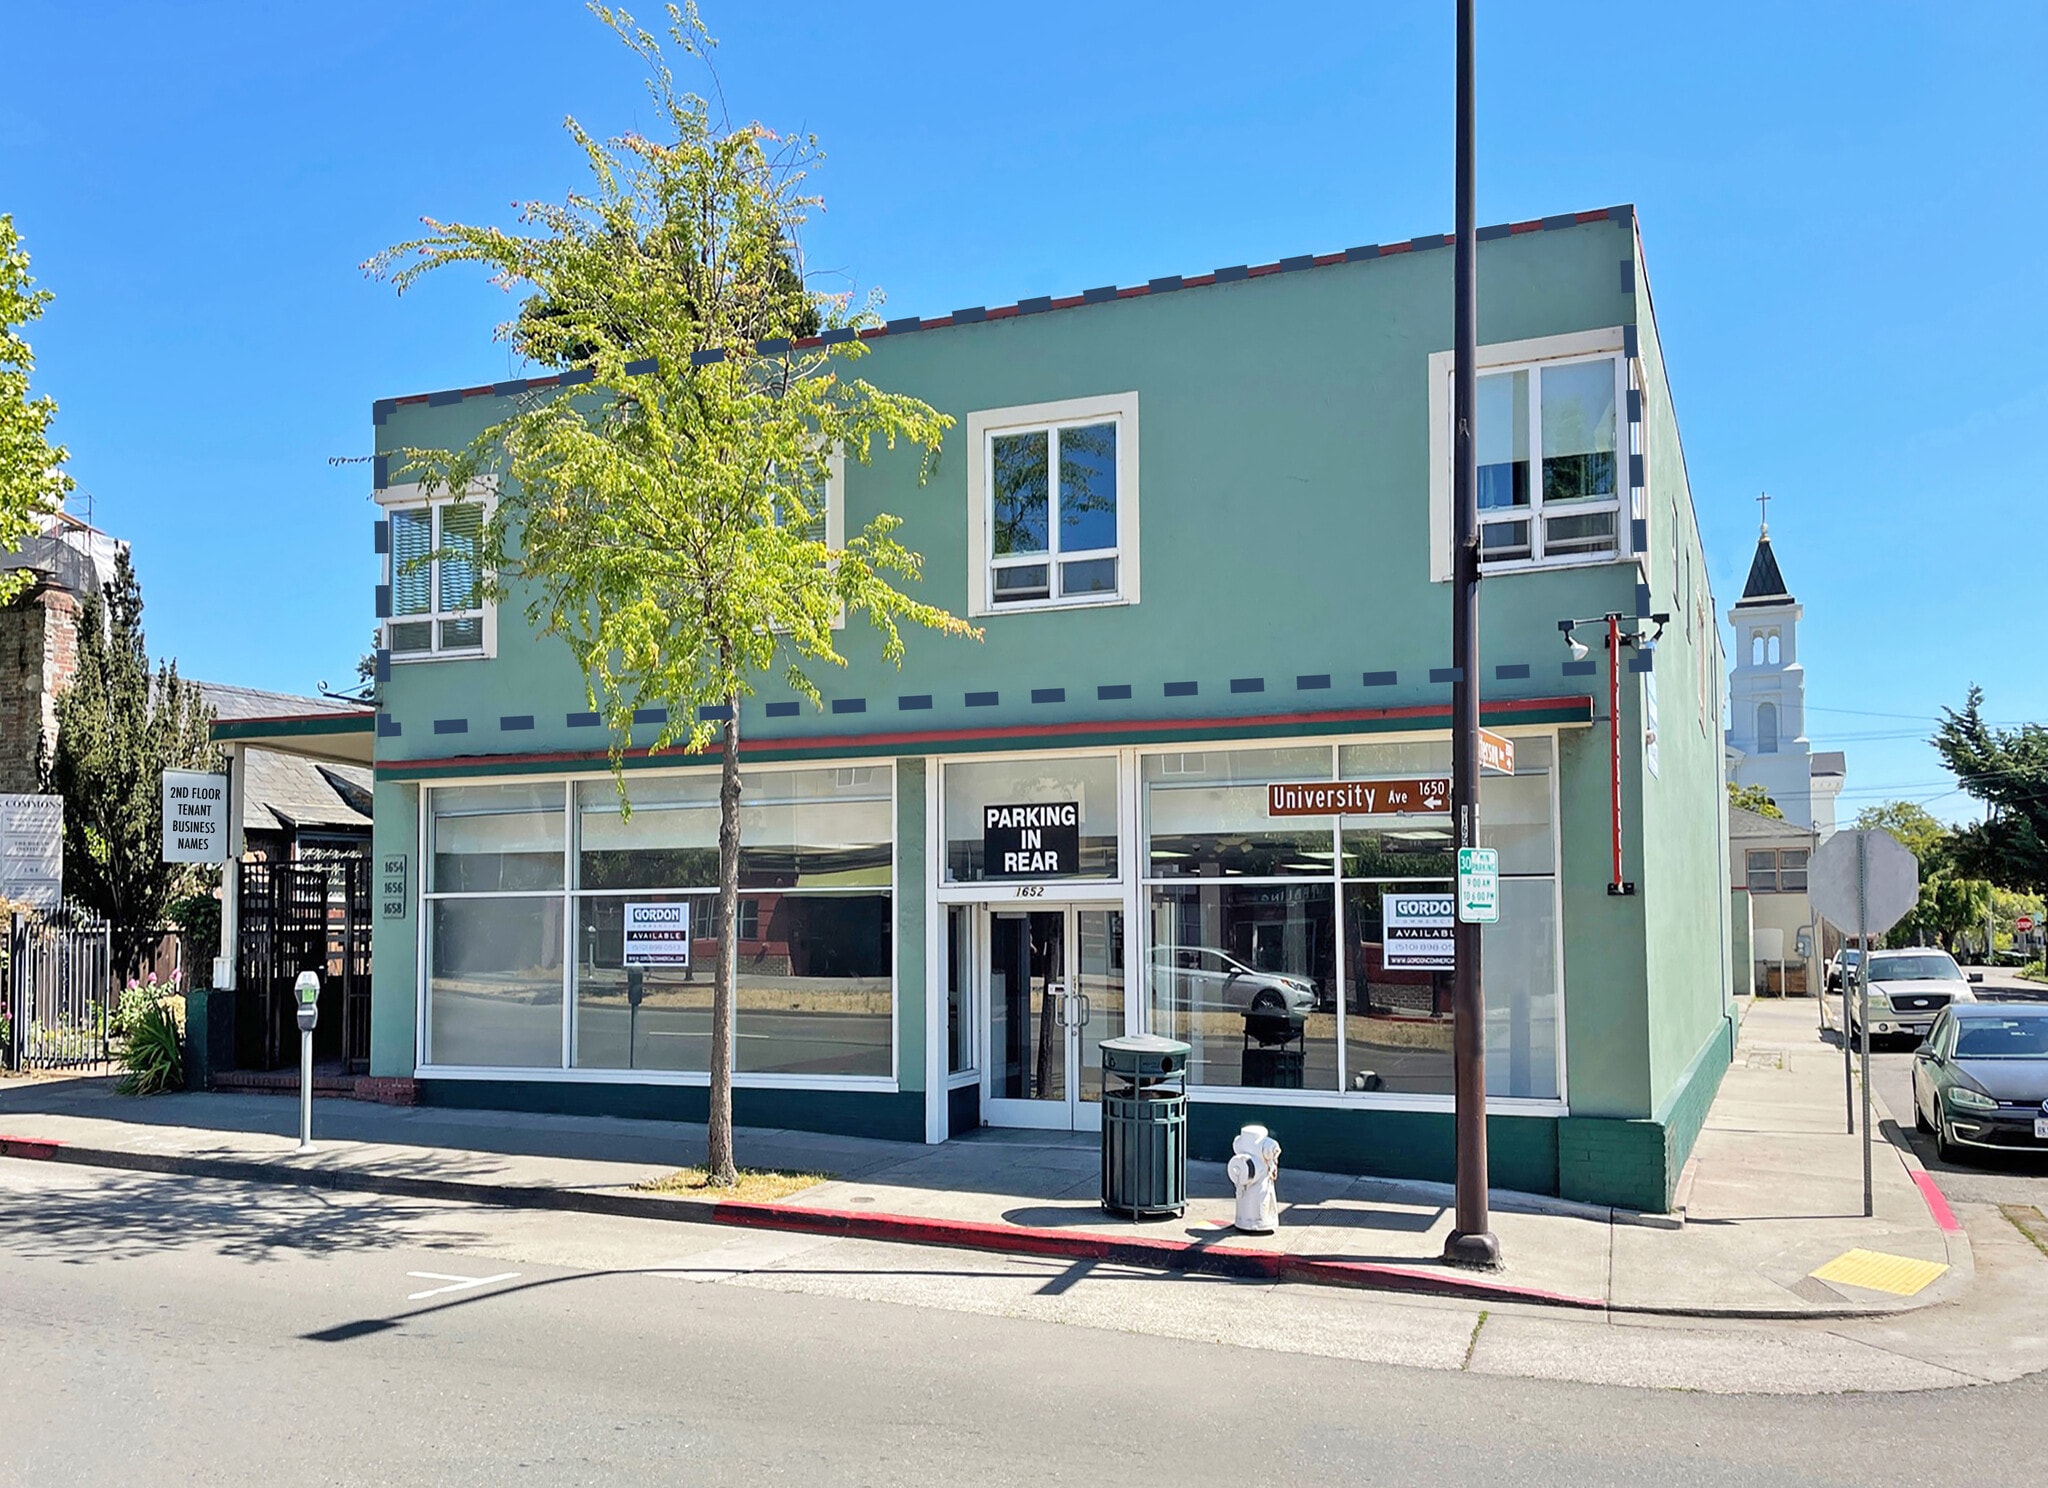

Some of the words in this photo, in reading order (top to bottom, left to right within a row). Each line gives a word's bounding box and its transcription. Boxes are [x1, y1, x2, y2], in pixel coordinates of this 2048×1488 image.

[170, 787, 189, 799] 2ND
[191, 787, 221, 800] FLOOR
[1274, 784, 1376, 813] University
[1388, 790, 1408, 804] Ave
[1419, 782, 1445, 796] 1650
[5, 800, 61, 809] COMMONS
[177, 803, 212, 817] TENANT
[987, 805, 1076, 829] PARKING
[172, 820, 216, 834] BUSINESS
[177, 838, 209, 850] NAMES
[1021, 829, 1041, 850] IN
[385, 861, 403, 873] 1654
[1004, 851, 1058, 872] REAR
[1460, 856, 1471, 870] 30
[384, 882, 403, 894] 1656
[1016, 887, 1045, 897] 1652
[384, 903, 402, 914] 1658
[634, 909, 680, 921] GORDON
[632, 932, 681, 940] AVAILABLE
[1396, 929, 1454, 938] AVAILABL
